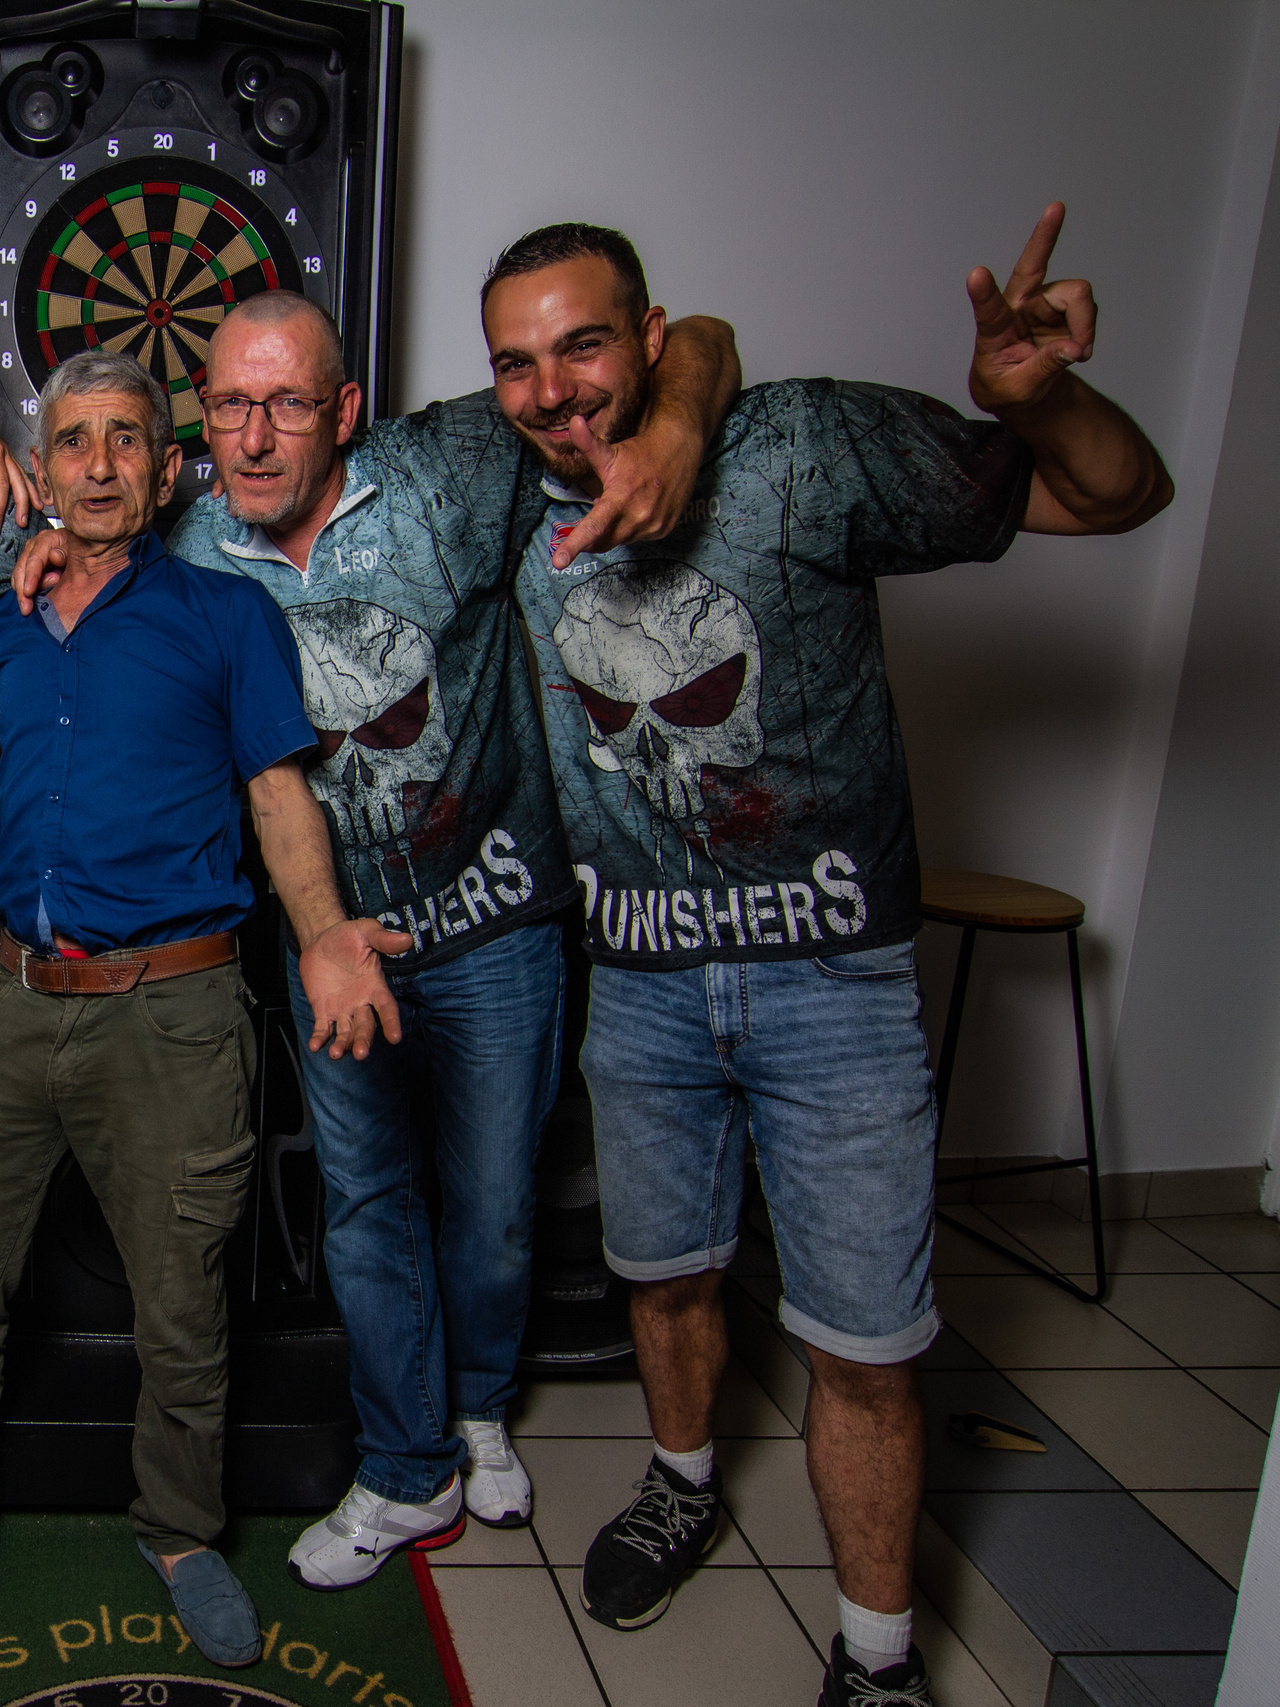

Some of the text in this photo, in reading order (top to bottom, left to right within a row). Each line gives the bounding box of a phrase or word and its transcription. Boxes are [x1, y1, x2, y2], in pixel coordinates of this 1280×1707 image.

[107, 138, 119, 157] 5
[154, 133, 173, 150] 20
[207, 143, 216, 161] 1
[59, 163, 76, 181] 12
[248, 169, 266, 187] 18
[25, 200, 37, 218] 9
[285, 207, 297, 226] 4
[303, 256, 321, 274] 13
[1, 351, 13, 369] 8
[20, 398, 38, 416] 16
[195, 463, 213, 480] 17
[571, 849, 867, 952] PUNISHERS
[120, 1683, 169, 1706] 20
